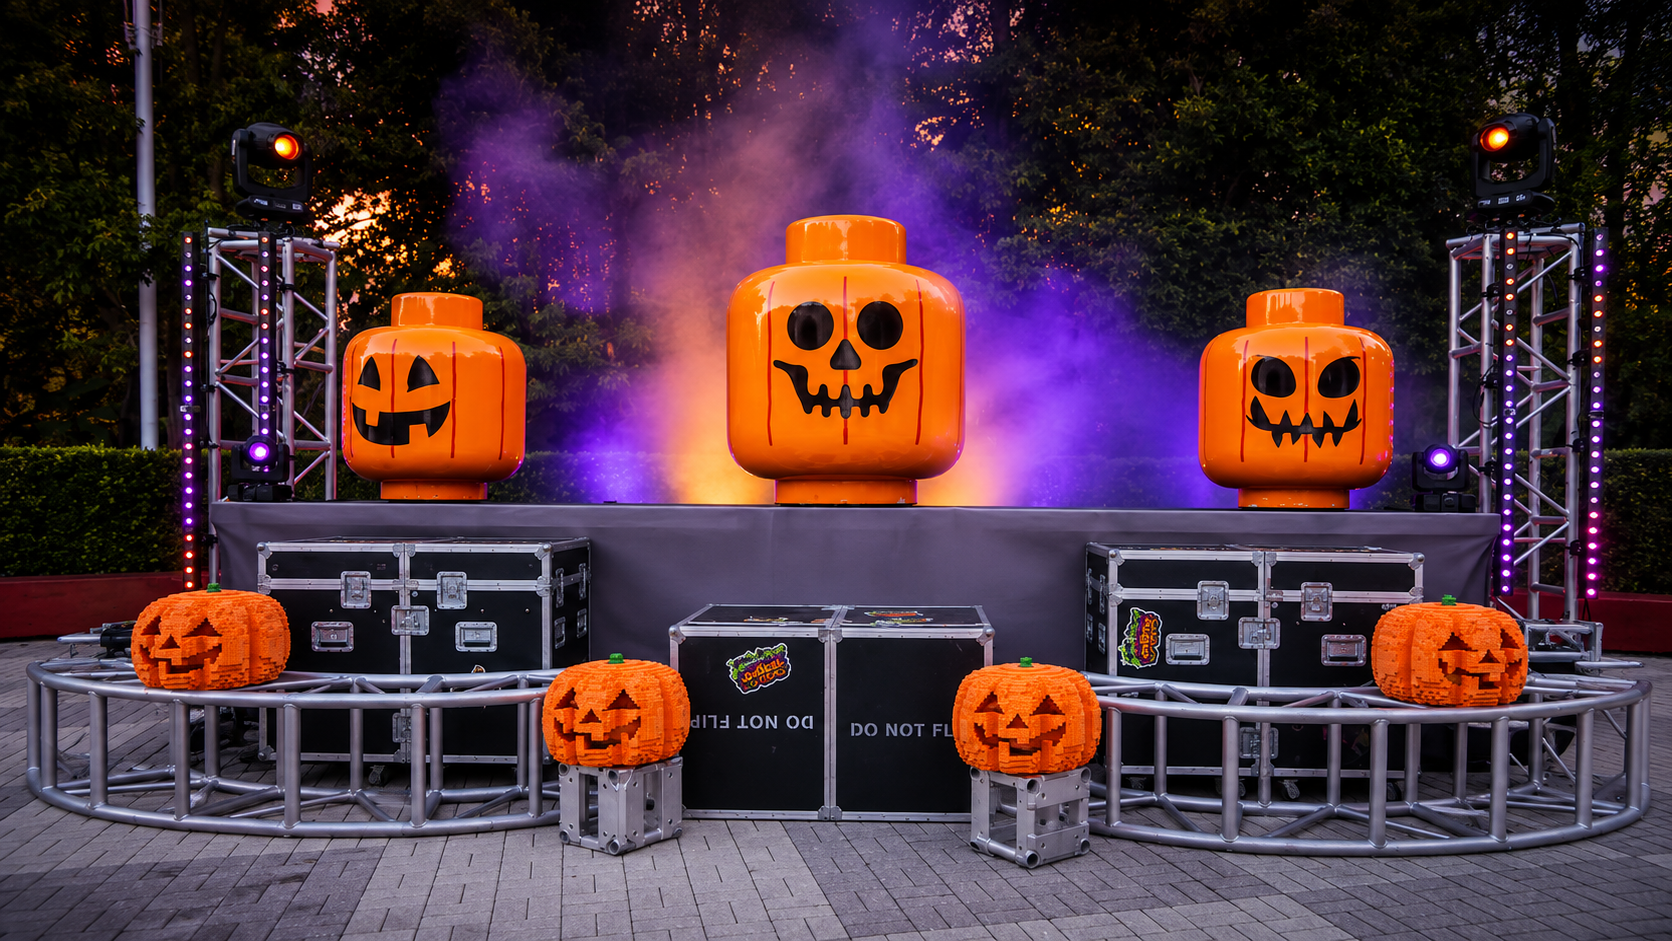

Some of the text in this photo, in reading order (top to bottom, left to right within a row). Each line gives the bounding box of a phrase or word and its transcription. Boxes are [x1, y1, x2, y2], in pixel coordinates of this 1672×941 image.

[690, 714, 814, 730] DO NOT FLIP
[850, 722, 878, 737] DO
[885, 722, 925, 737] NOT
